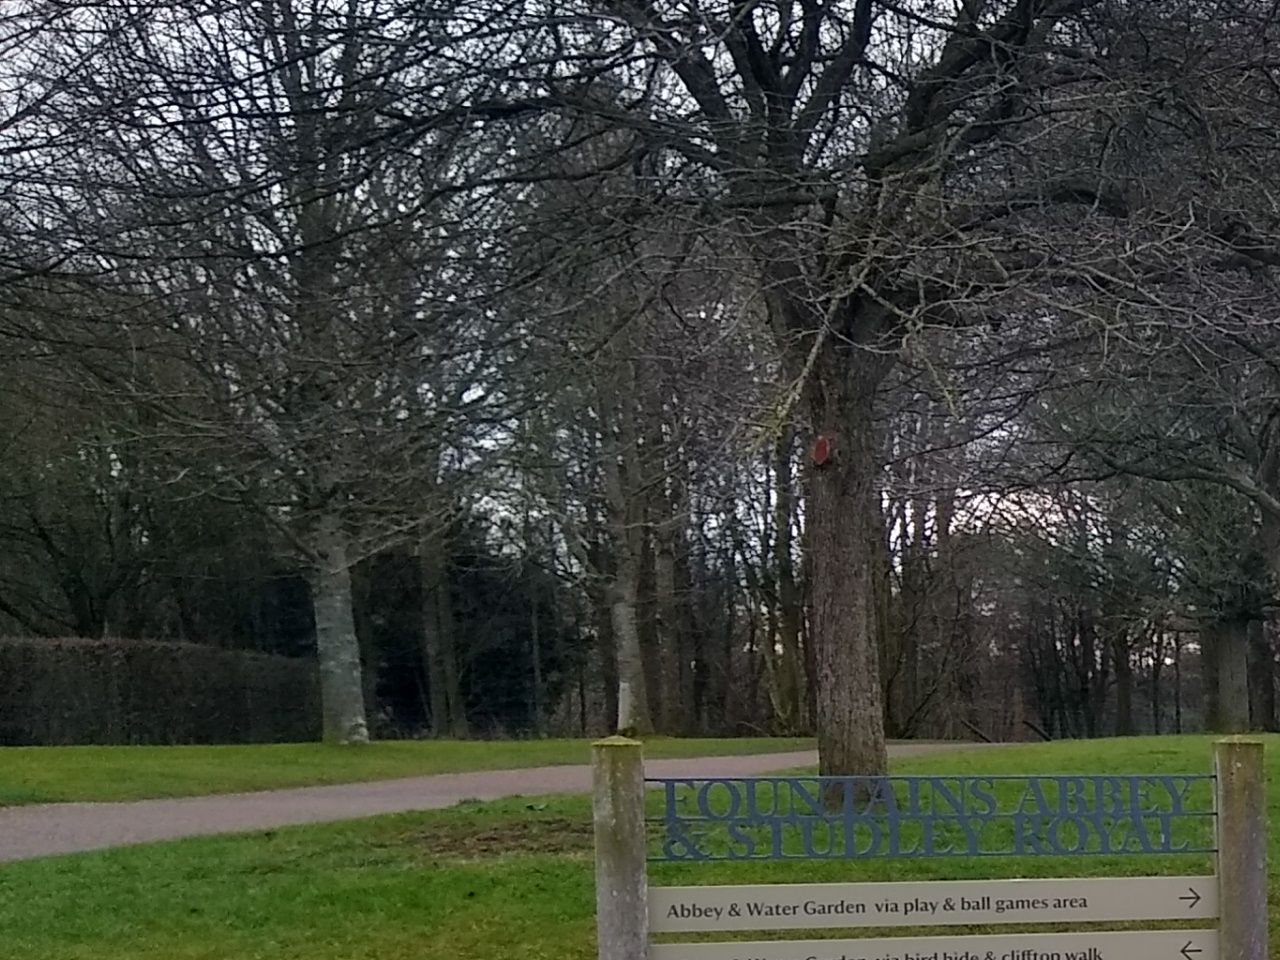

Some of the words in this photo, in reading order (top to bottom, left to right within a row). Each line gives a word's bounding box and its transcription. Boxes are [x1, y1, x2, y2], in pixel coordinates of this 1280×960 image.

[662, 776, 997, 821] FOUNTAINS
[1016, 775, 1196, 816] ABBEY
[662, 820, 713, 860] &
[727, 815, 988, 859] STUDLEY
[1015, 813, 1191, 856] ROYAL
[667, 903, 724, 920] Abbey
[728, 903, 742, 917] &
[746, 902, 800, 917] Water
[803, 900, 866, 915] Garden
[875, 899, 899, 914] via
[904, 898, 939, 915] play
[943, 898, 956, 912] &
[960, 896, 991, 911] ball
[995, 898, 1049, 913] games
[1052, 897, 1088, 910] area
